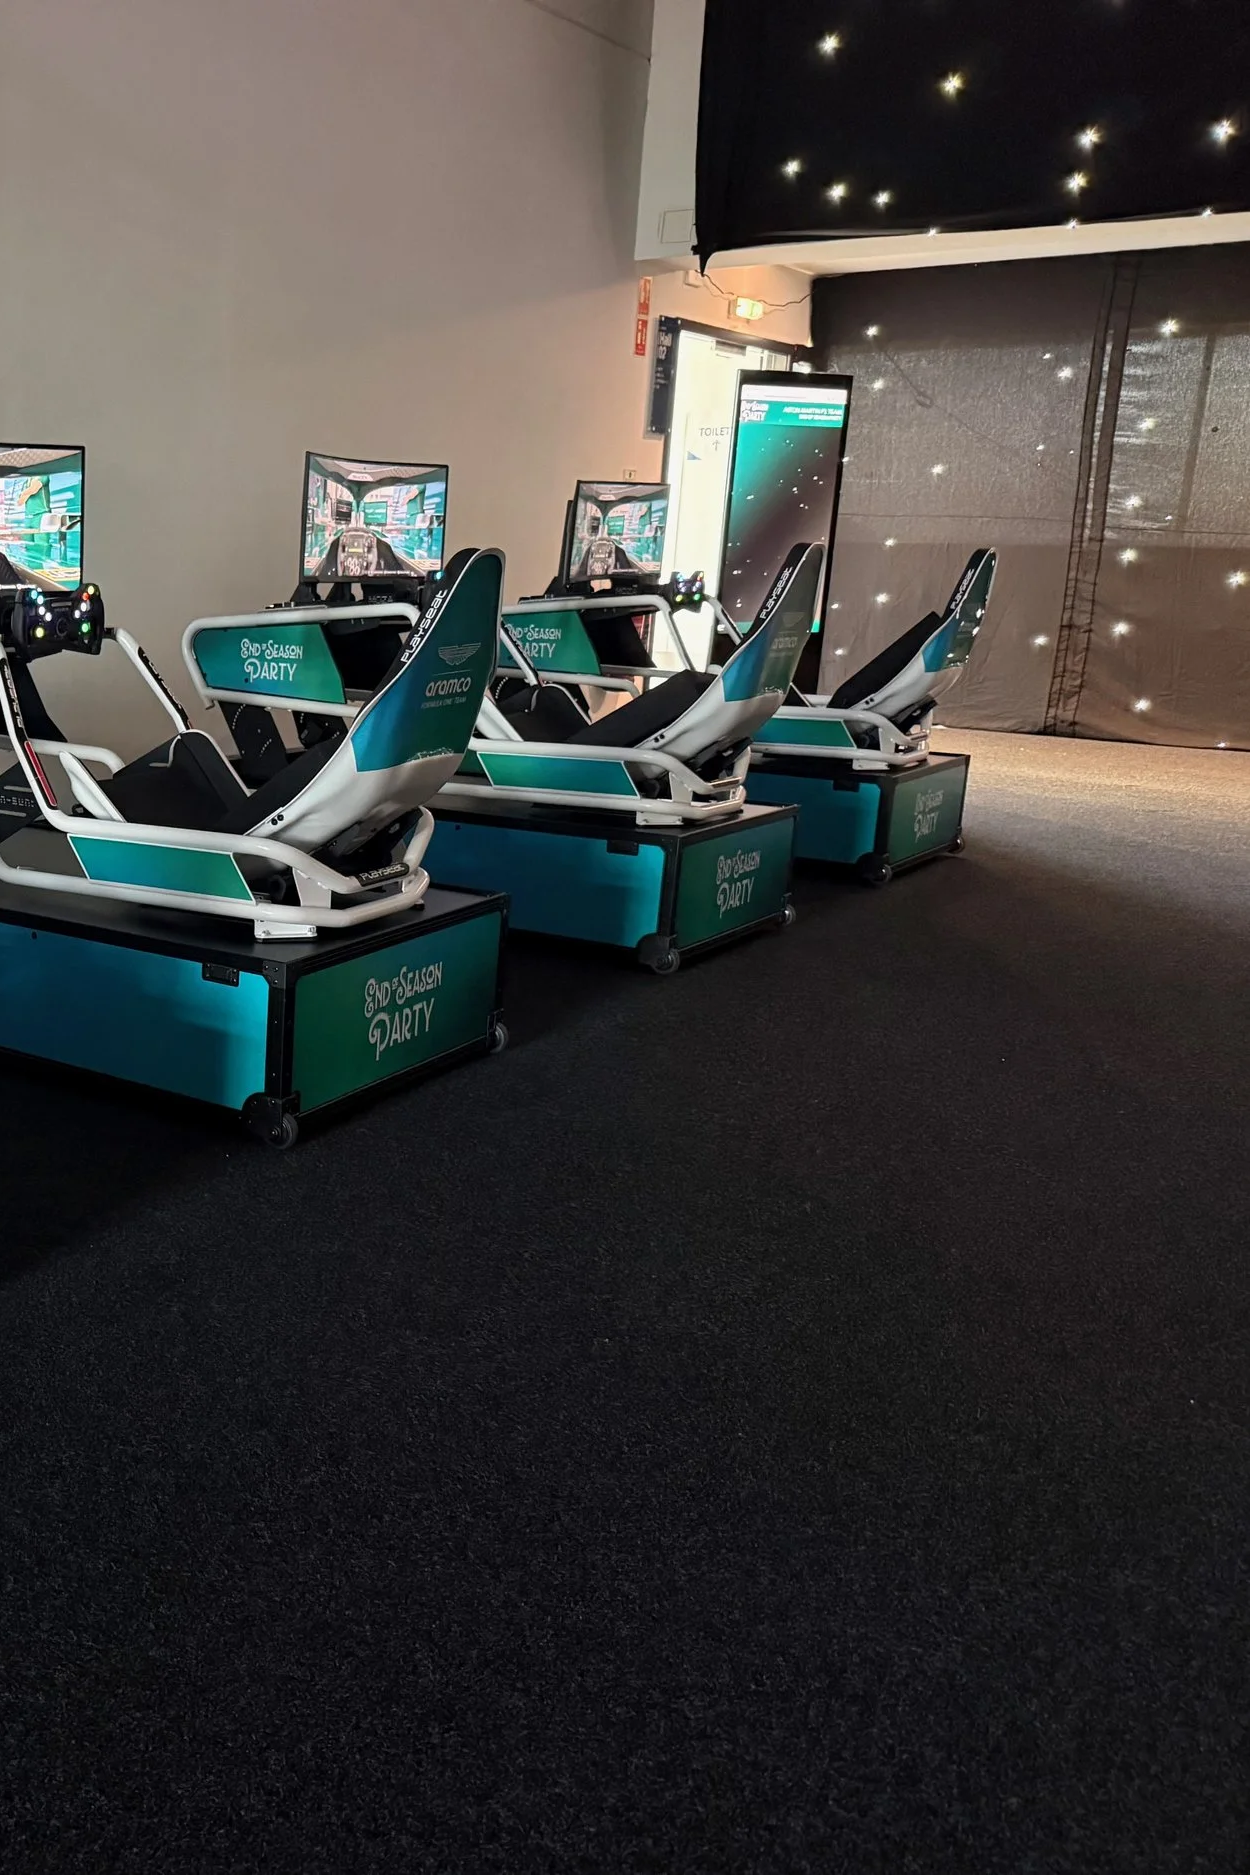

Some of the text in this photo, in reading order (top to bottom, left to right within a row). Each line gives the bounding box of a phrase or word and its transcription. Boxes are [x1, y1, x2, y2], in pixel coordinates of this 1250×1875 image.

[699, 426, 730, 437] TOILET
[526, 624, 562, 640] SEASON
[241, 638, 261, 658] END
[264, 639, 303, 659] SEASON
[518, 640, 556, 658] ARTY
[244, 658, 297, 683] PARTY
[425, 677, 471, 697] aramco
[717, 876, 755, 919] PARTY
[364, 977, 390, 1018] END
[396, 961, 443, 1005] SEASON
[368, 997, 435, 1061] PARTY
